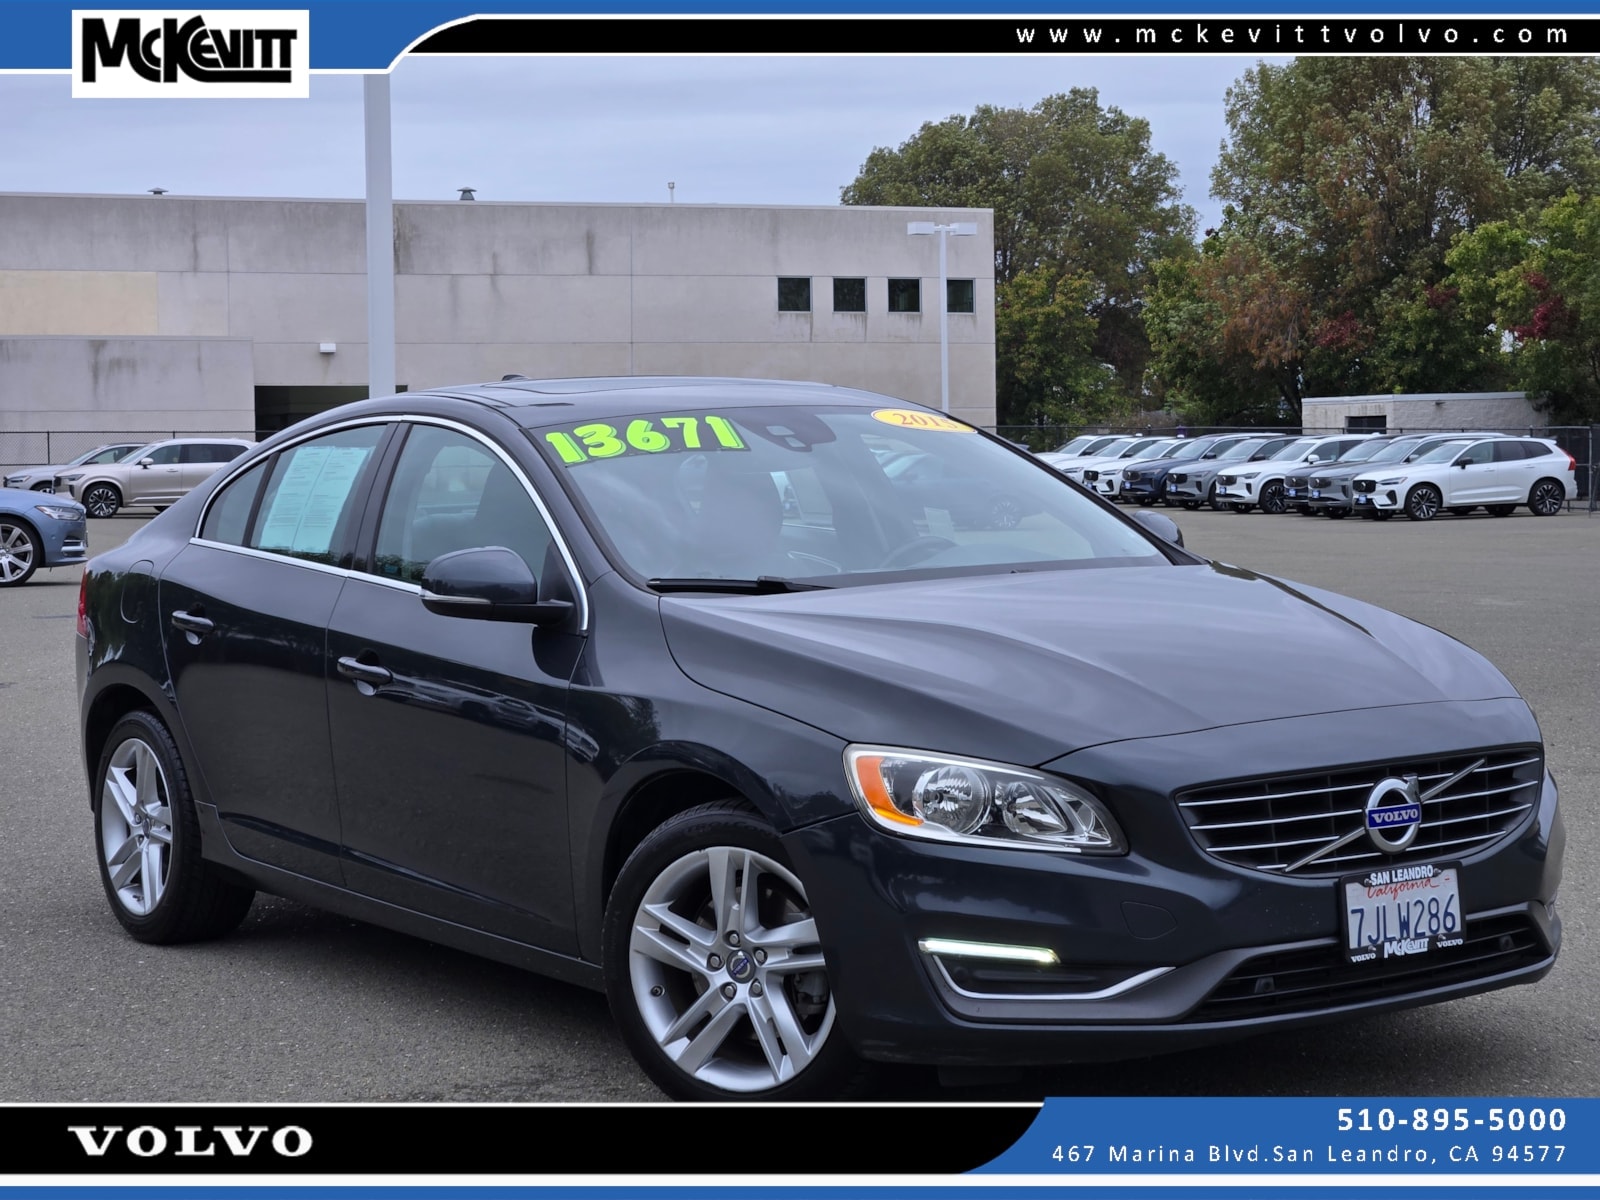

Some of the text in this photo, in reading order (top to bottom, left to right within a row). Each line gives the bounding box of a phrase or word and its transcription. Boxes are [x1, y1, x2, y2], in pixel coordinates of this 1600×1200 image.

[545, 416, 744, 463] 13671
[1371, 808, 1418, 824] VOLVO
[1370, 865, 1433, 885] SAN LEANDRO
[1367, 878, 1440, 901] California
[1351, 894, 1456, 948] 7JLW286
[1437, 938, 1463, 948] VOLVO
[1351, 952, 1376, 963] VOLVO
